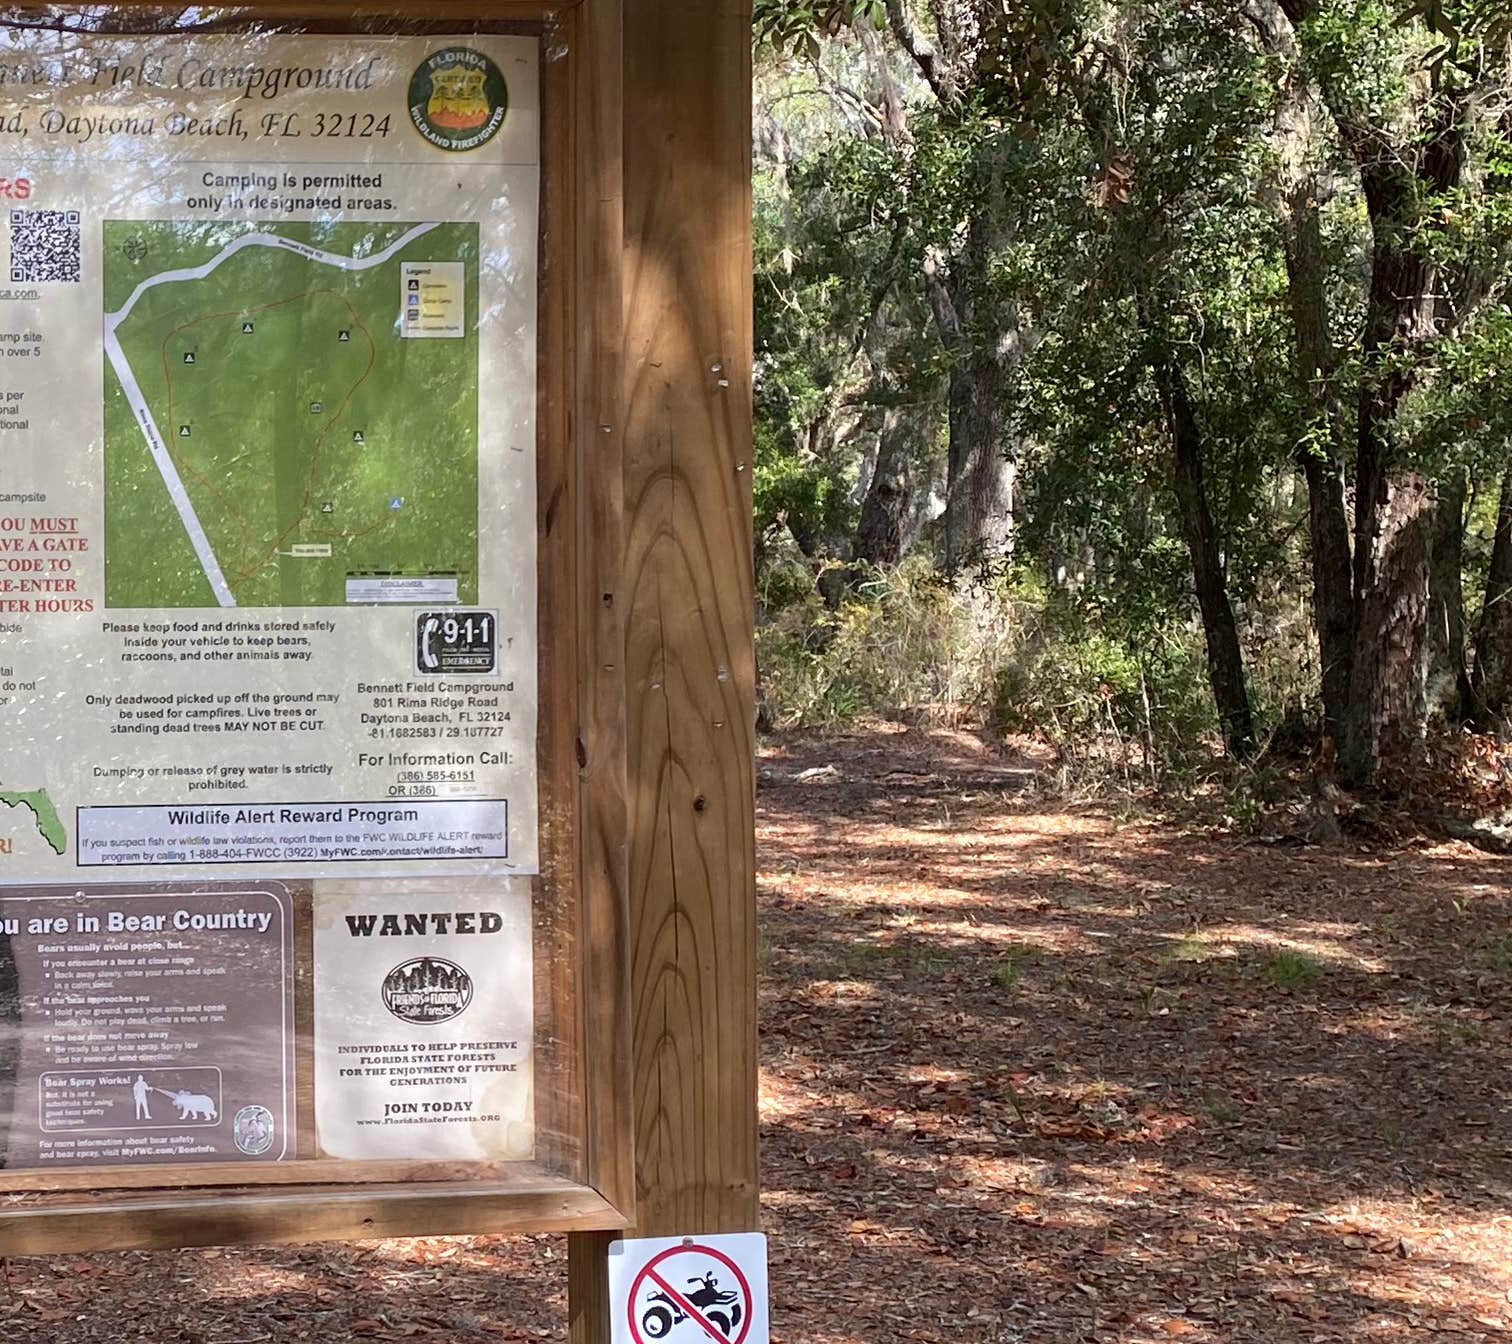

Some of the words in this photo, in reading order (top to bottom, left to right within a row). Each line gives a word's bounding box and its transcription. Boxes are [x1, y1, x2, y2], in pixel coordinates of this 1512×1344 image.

[428, 52, 487, 70] FLORIDA
[92, 54, 172, 86] Field
[177, 58, 381, 98] Campground
[40, 111, 154, 143] Daytona
[164, 108, 248, 141] Beach,
[261, 113, 299, 137] FL
[310, 113, 391, 138] 32124
[410, 104, 449, 148] WILDLAND
[451, 106, 504, 149] FIREFIGHTER
[201, 171, 277, 191] Camping
[282, 172, 297, 187] is
[302, 173, 382, 191] permitted
[186, 194, 223, 212] only
[228, 194, 246, 210] in
[248, 194, 342, 213] designated
[346, 198, 397, 210] areas.
[30, 517, 78, 531] MUST
[27, 538, 39, 551] A
[42, 537, 88, 551] GATE
[47, 558, 71, 572] TO
[34, 598, 93, 612] HOURS
[102, 622, 140, 632] Please
[142, 622, 173, 634] keep
[172, 621, 198, 632] food
[201, 621, 222, 631] and
[224, 621, 261, 632] drinks
[263, 620, 299, 631] stored
[302, 620, 336, 633] safely
[443, 617, 489, 644] 9-1-1
[357, 682, 403, 693] Bennett
[406, 681, 435, 693] Field
[437, 681, 514, 694] Campground
[372, 697, 393, 708] 801
[396, 697, 427, 708] Rima
[430, 696, 464, 710] Ridge
[467, 696, 498, 707] Road
[360, 712, 408, 726] Daytona
[412, 712, 452, 723] Beach,
[458, 711, 473, 722] FL
[476, 711, 511, 722] 32124
[110, 722, 159, 735] standing
[162, 722, 190, 733] dead
[192, 723, 221, 732] trees
[224, 721, 249, 731] MAY
[252, 720, 277, 731] NOT
[280, 720, 296, 731] BE
[358, 753, 384, 766] For
[387, 751, 474, 766] Information
[479, 751, 513, 764] Call:
[426, 769, 475, 780] 585-6151
[388, 785, 406, 795] OR
[167, 810, 230, 825] Wildlife
[234, 809, 275, 824] Alert
[280, 808, 342, 823] Reward
[347, 807, 418, 825] Program
[27, 917, 68, 934] are
[76, 913, 100, 933] in
[107, 912, 165, 932] Bear
[173, 909, 272, 932] Country
[344, 912, 502, 937] WANTED
[337, 1044, 408, 1054] INDIVIDUALS
[410, 1043, 426, 1052] TO
[428, 1042, 457, 1051] HELP
[459, 1040, 517, 1050] PRESERVE
[359, 1055, 409, 1065] FLORIDA
[410, 1054, 445, 1063] STATE
[446, 1052, 496, 1062] FORESTS
[339, 1068, 362, 1076] FOR
[364, 1067, 387, 1076] THE
[388, 1065, 455, 1076] ENJOYMENT
[457, 1064, 472, 1073] OF
[474, 1063, 517, 1072] FUTURE
[44, 1077, 67, 1087] Bear
[68, 1077, 96, 1087] Spray
[98, 1075, 131, 1085] Works!
[389, 1076, 467, 1086] GENERATIONS
[384, 1102, 418, 1115] JOIN
[421, 1101, 472, 1112] TODAY
